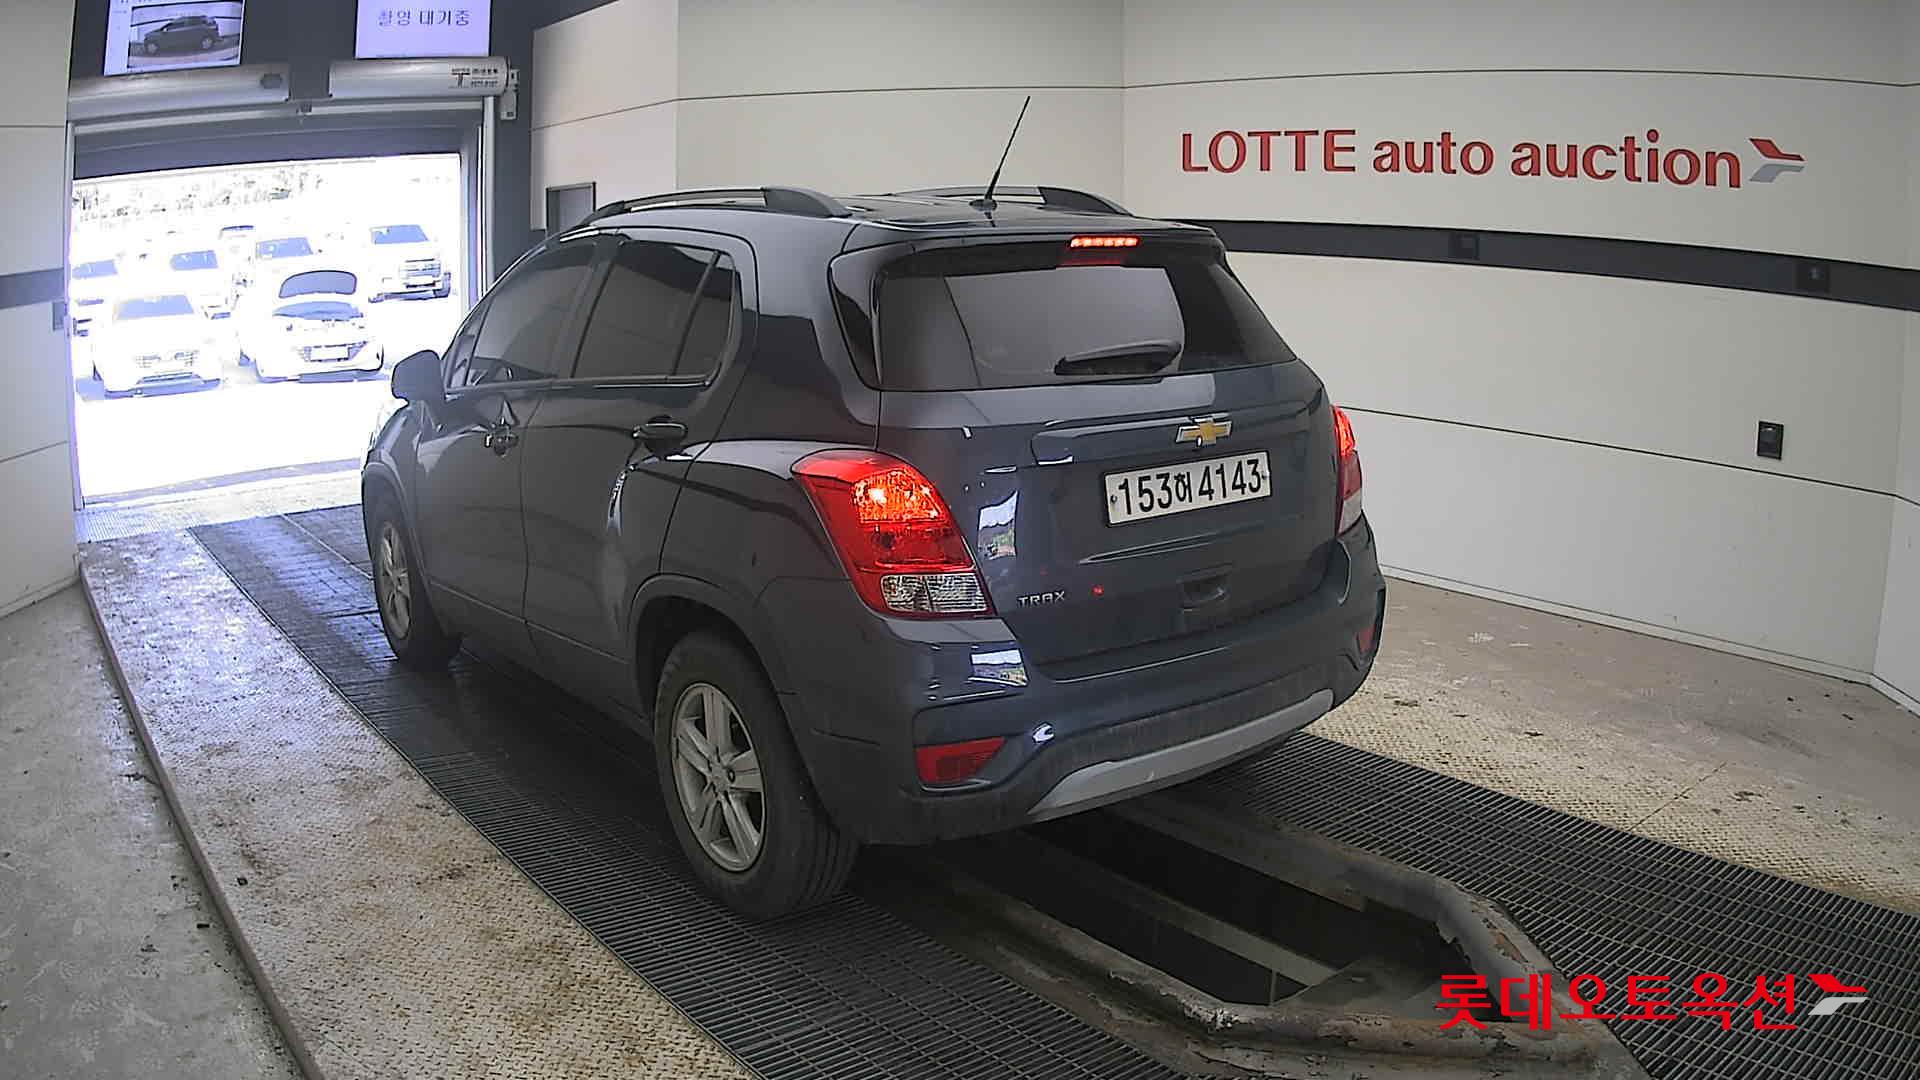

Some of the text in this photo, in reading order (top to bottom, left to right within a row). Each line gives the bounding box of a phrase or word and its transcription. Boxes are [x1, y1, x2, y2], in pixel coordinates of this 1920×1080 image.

[419, 9, 469, 26] 대기중
[1182, 128, 1741, 188] LOTTE auto auction
[1018, 590, 1065, 606] TRAX
